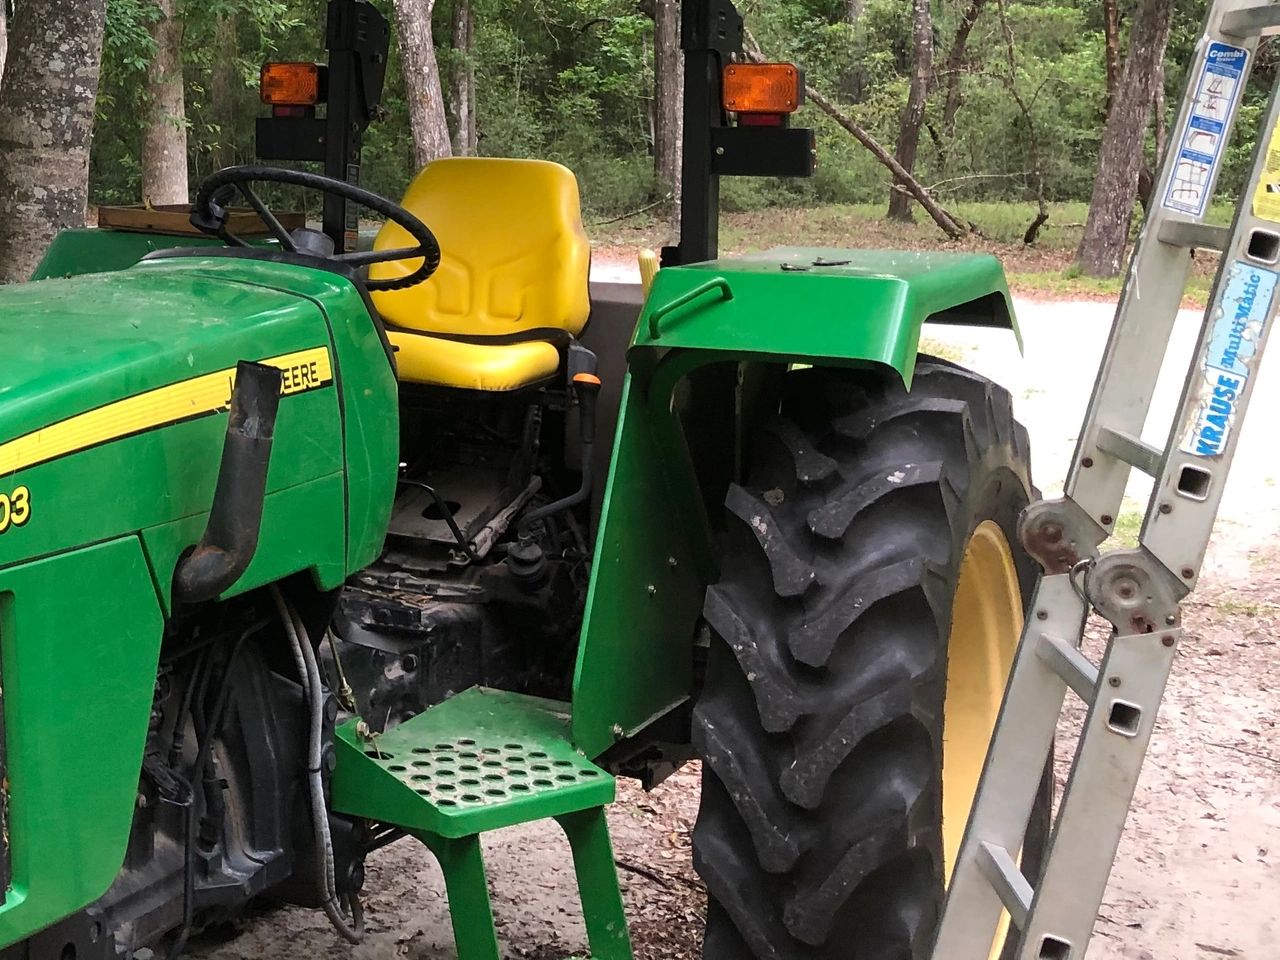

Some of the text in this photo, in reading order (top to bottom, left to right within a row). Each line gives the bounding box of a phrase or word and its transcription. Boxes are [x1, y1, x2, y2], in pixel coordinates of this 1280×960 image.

[1209, 49, 1245, 58] Combi
[281, 361, 319, 390] EERE
[1195, 374, 1240, 456] KRAUSE
